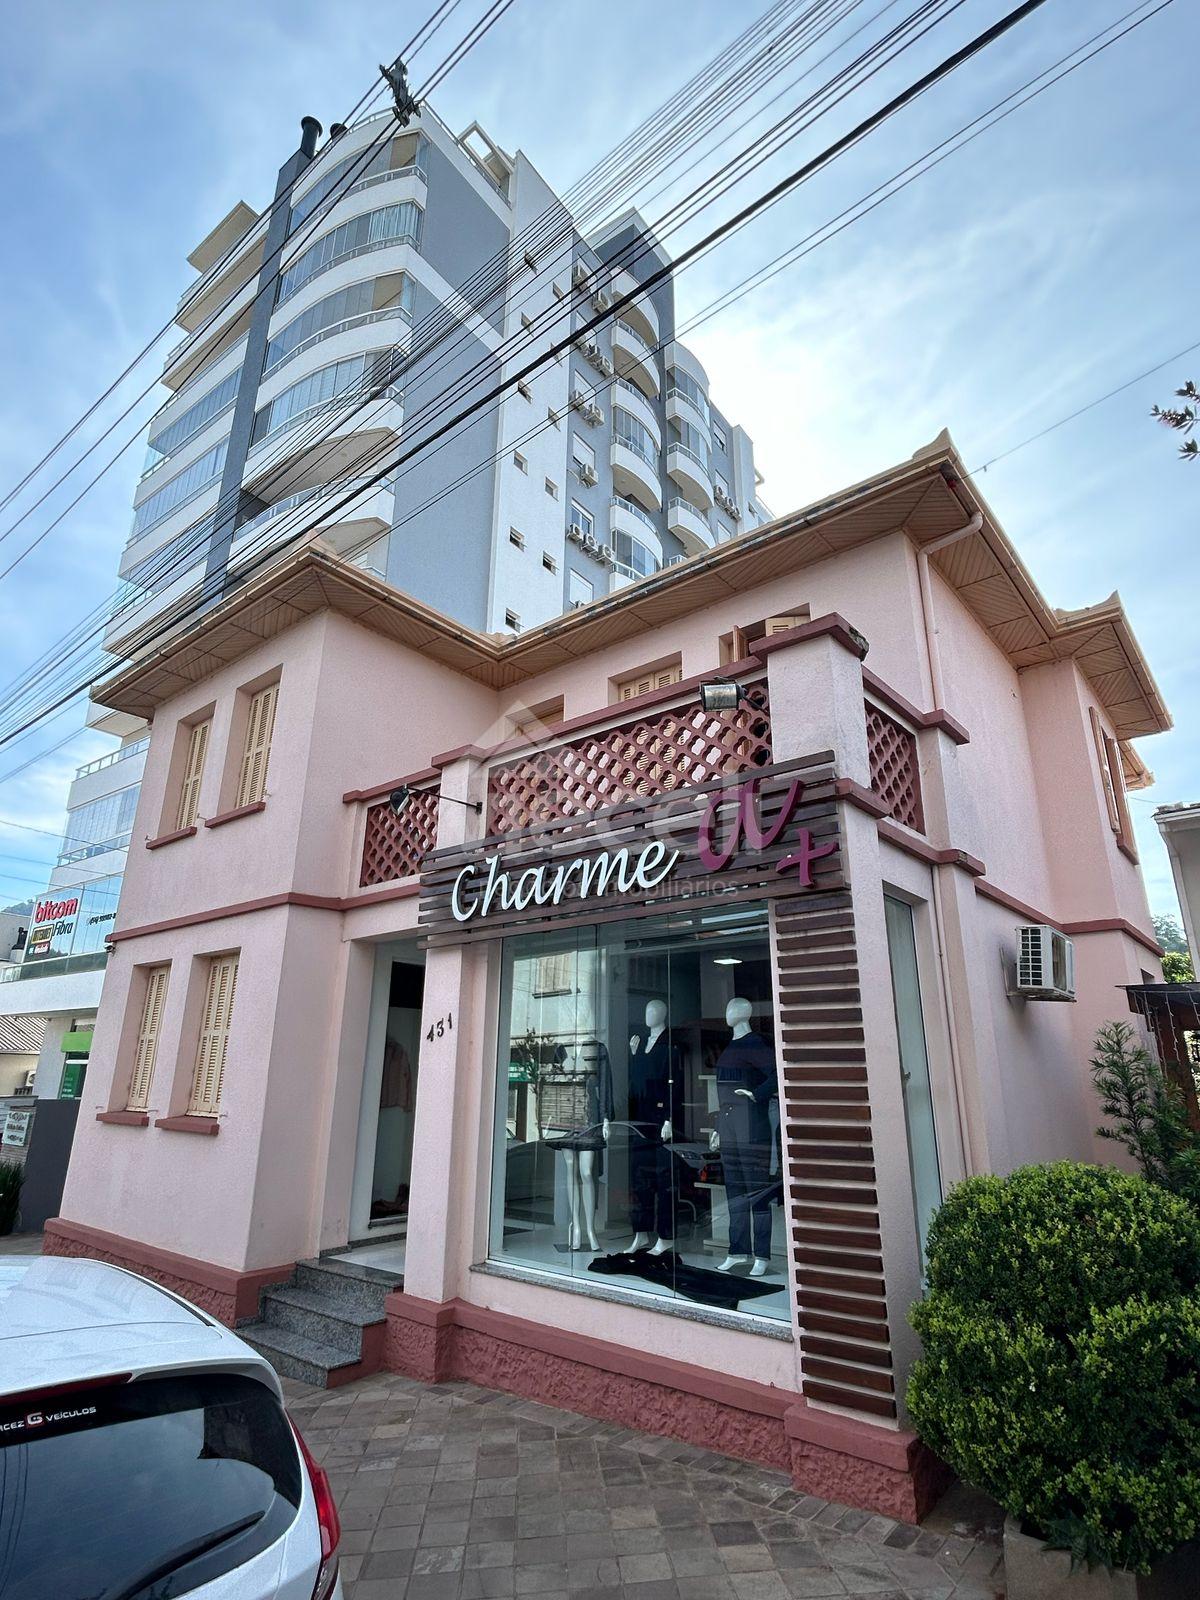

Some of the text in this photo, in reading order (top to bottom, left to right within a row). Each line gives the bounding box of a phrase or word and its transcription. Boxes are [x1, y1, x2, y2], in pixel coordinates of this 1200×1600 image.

[451, 839, 680, 922] Charme
[35, 898, 78, 923] bitcom
[52, 920, 74, 937] Fibra
